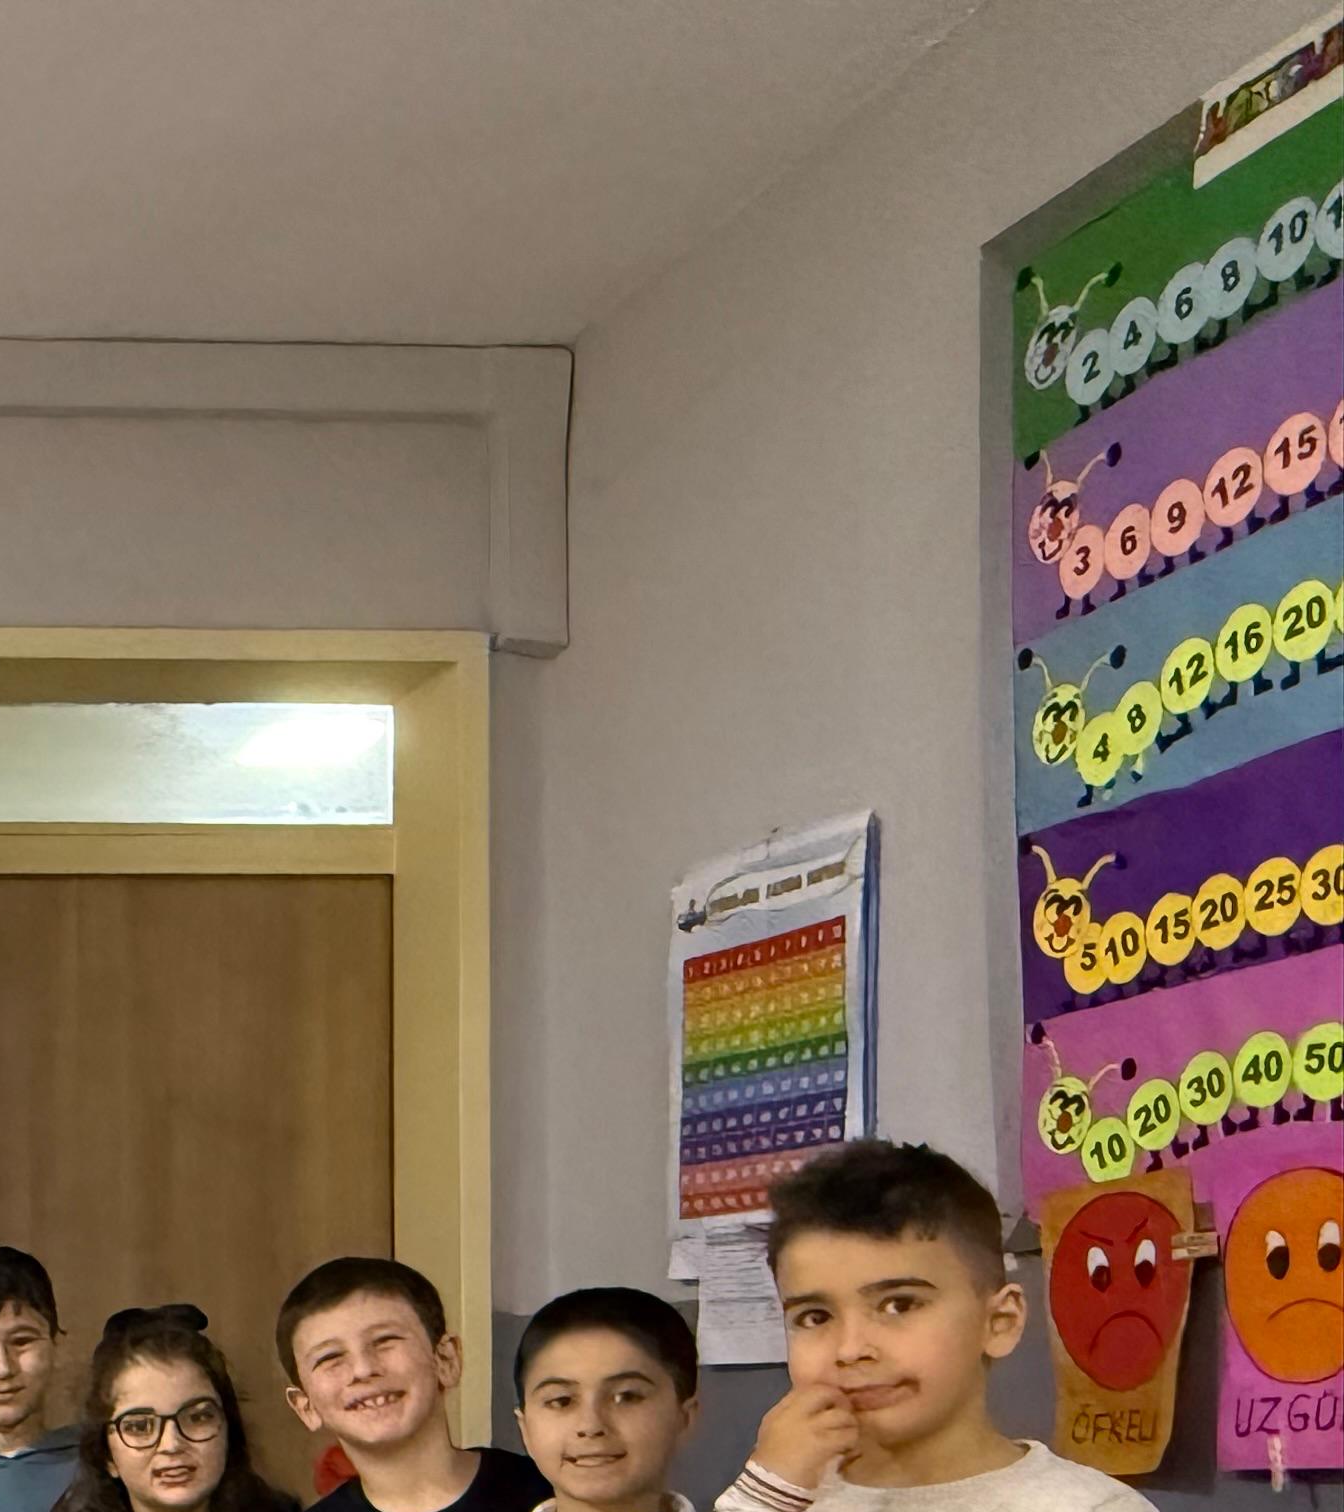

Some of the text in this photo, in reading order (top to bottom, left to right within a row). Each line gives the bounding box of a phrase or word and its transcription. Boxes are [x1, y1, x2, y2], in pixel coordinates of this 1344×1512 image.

[1082, 350, 1100, 384] 2
[1123, 320, 1142, 350] 4
[1175, 286, 1193, 320] 6
[1221, 260, 1240, 292] 8
[1267, 210, 1309, 256] 10
[1073, 424, 1317, 576] 3 6 9 12 15
[1093, 595, 1326, 763] 4 8 12 16 20
[1080, 943, 1097, 971] 5
[1105, 927, 1139, 966] 10
[1154, 909, 1190, 944] 15
[1199, 891, 1238, 931] 20
[1253, 873, 1297, 911] 25
[1089, 1133, 1126, 1170] 10
[1133, 1093, 1172, 1138] 20
[1186, 1067, 1225, 1108] 30
[1241, 1050, 1283, 1085] 40
